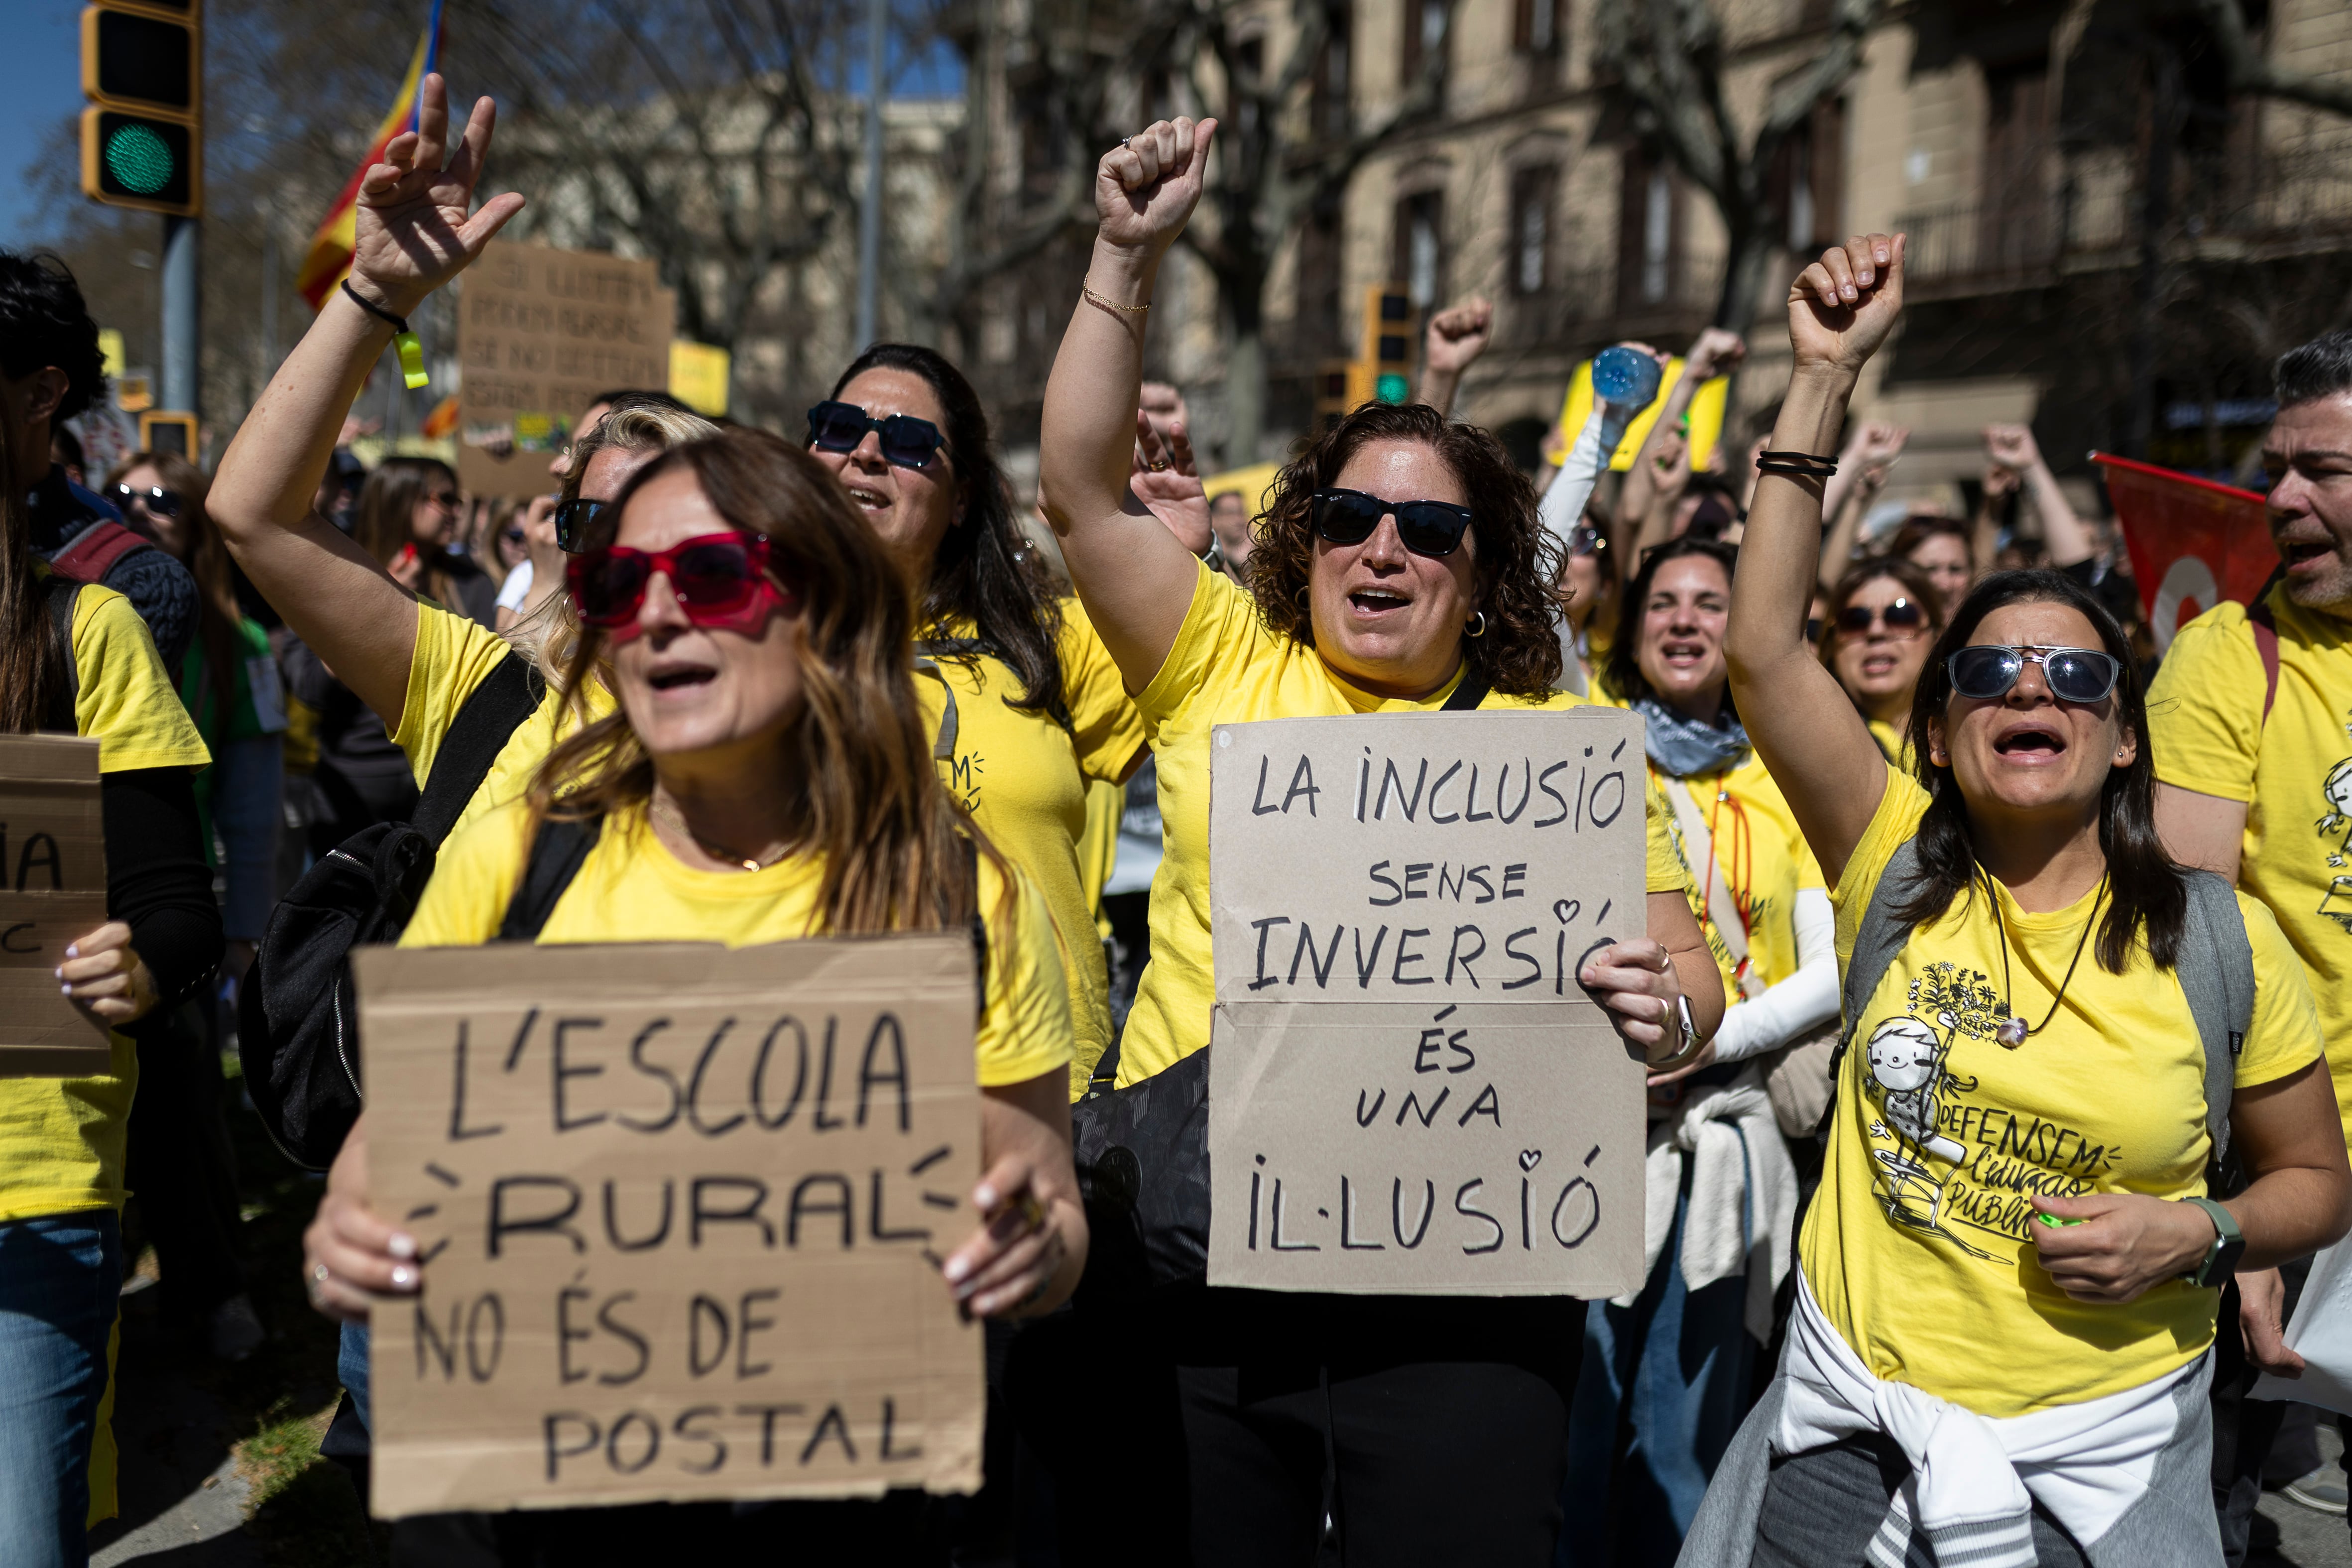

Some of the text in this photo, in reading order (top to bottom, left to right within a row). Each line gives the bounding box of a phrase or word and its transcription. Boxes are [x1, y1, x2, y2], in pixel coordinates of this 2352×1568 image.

[1251, 754, 1321, 818] LA
[1368, 860, 1528, 907] SENSE
[448, 1007, 912, 1142] L'ESCOLA
[1413, 1003, 1475, 1075] ÉS
[1356, 1084, 1502, 1128] UNA
[1940, 1105, 2105, 1174] DEFENSEM
[485, 1168, 933, 1261] RURAL
[413, 1267, 783, 1386] NO ÉS DE
[543, 1397, 926, 1482] POSTAL
